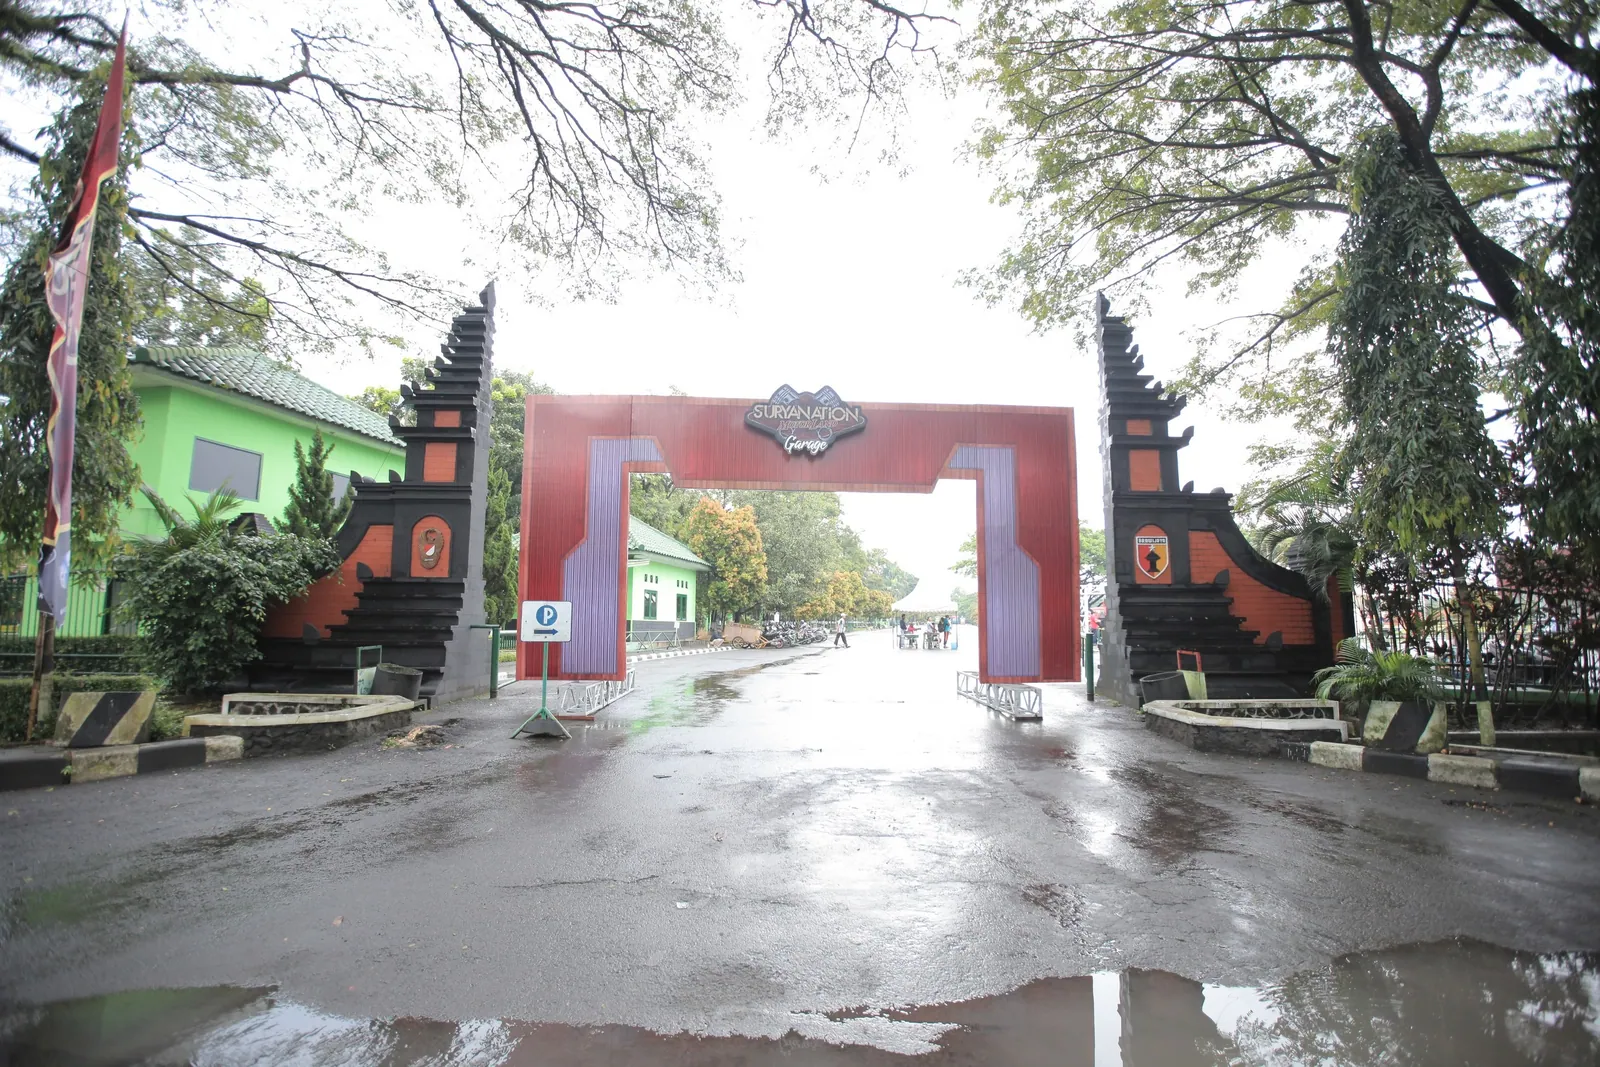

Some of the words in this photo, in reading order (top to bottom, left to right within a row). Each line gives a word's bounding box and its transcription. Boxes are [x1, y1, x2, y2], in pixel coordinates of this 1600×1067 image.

[753, 404, 859, 422] SURYANATION
[784, 435, 828, 455] Garage
[543, 607, 554, 625] P
